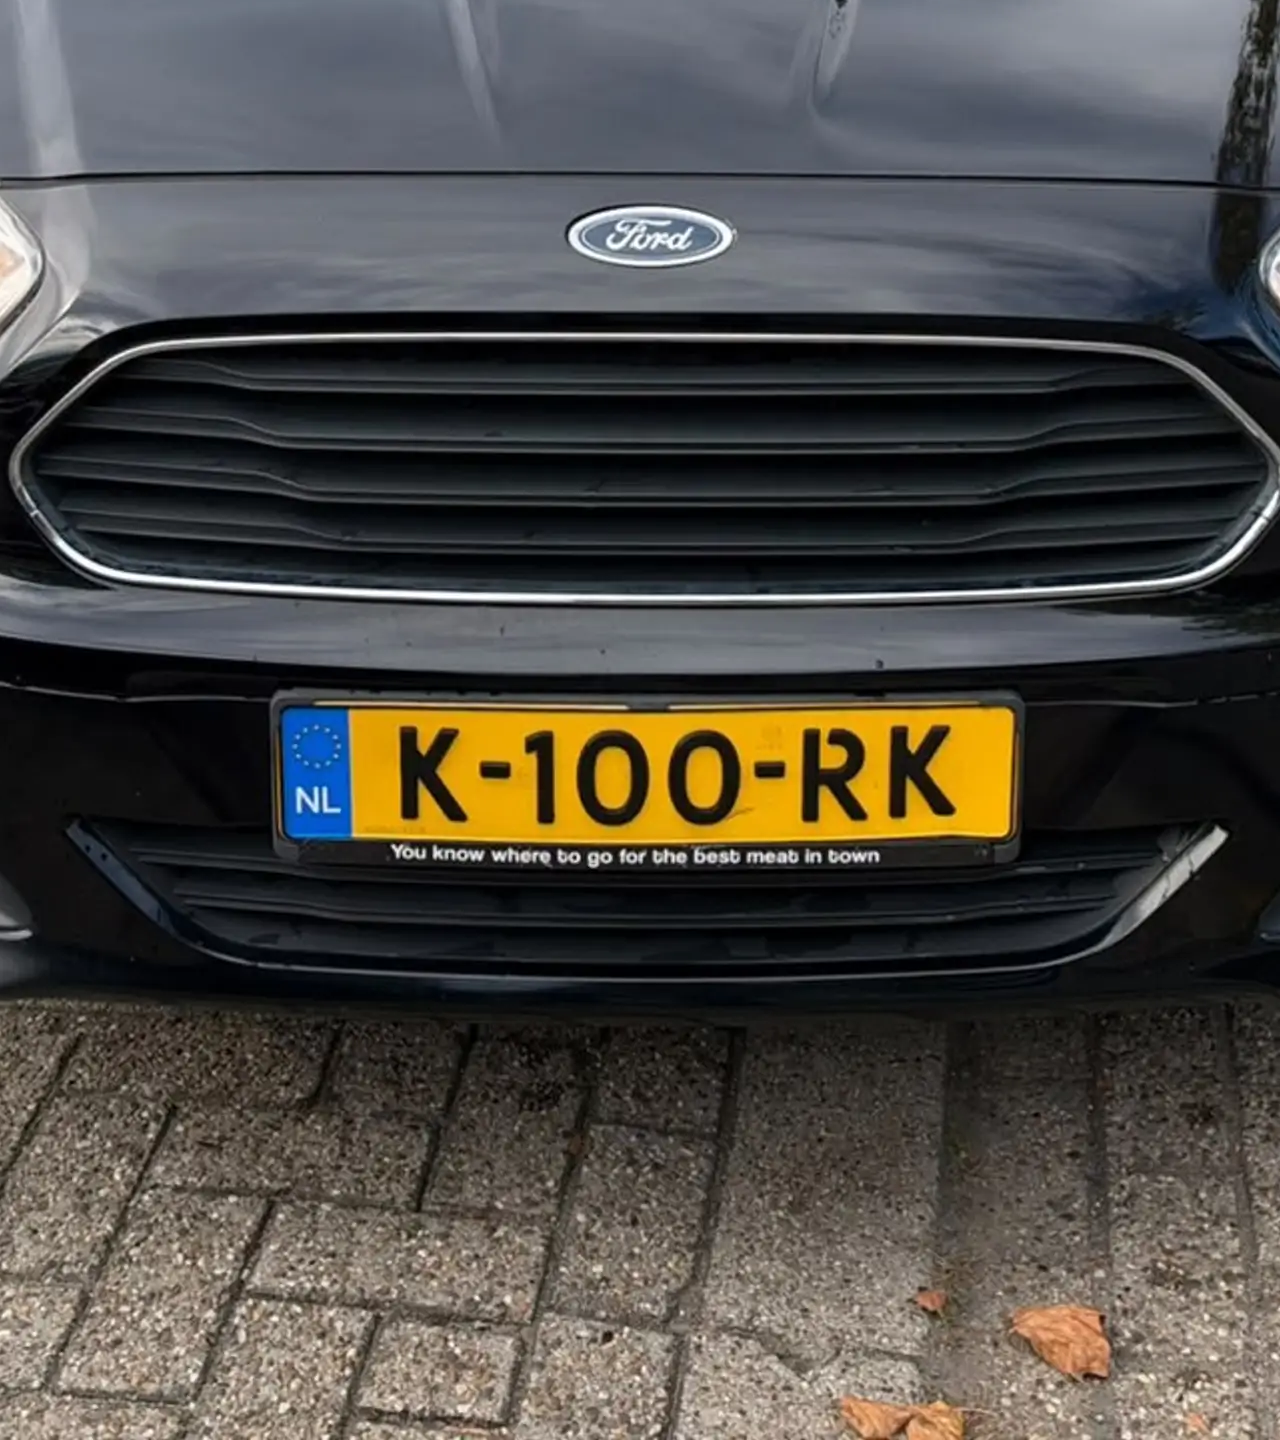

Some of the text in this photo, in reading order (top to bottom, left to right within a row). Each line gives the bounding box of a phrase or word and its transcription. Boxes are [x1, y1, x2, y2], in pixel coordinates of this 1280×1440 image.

[605, 219, 695, 251] Ford
[398, 725, 958, 827] K-100-RK
[295, 786, 342, 814] NL
[390, 843, 881, 869] You know where to go for the best meat in town
